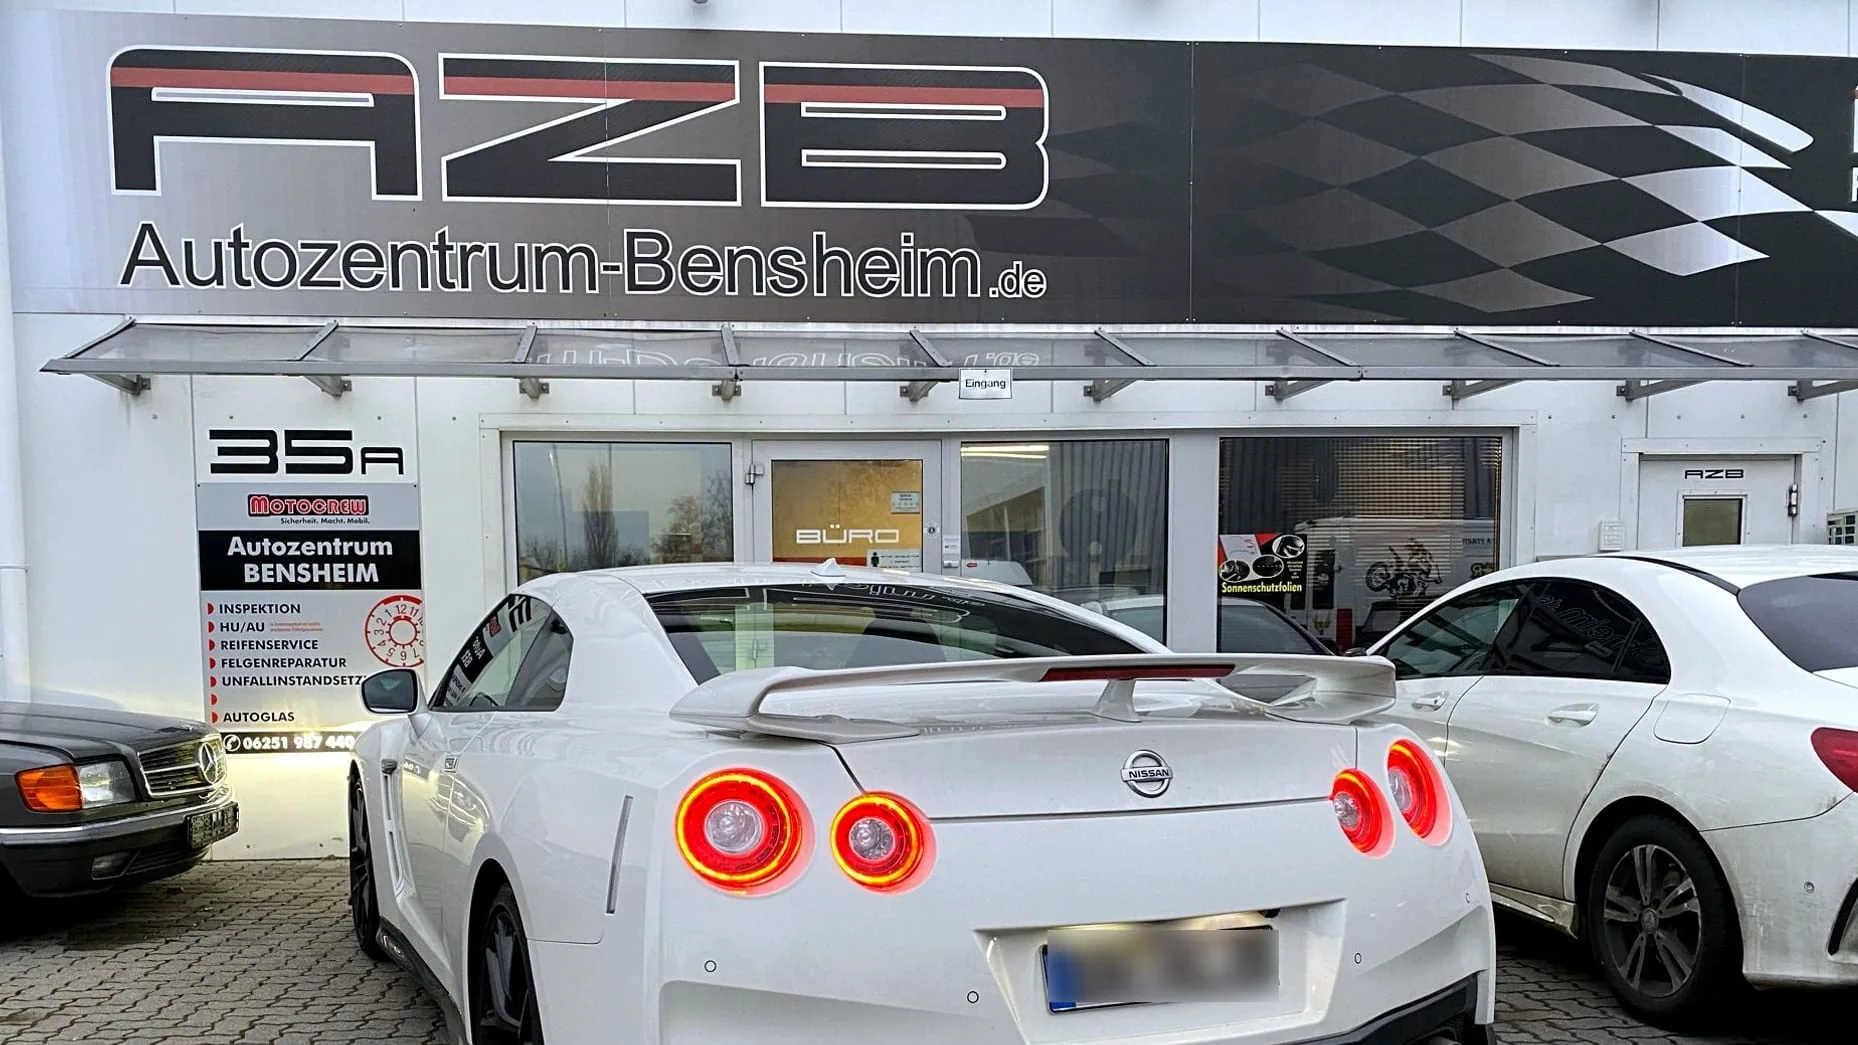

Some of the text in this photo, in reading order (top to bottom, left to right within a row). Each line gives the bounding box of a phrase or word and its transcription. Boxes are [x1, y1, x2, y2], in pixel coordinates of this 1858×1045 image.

[106, 44, 1050, 211] AZB
[965, 378, 1006, 389] Eingang
[1684, 469, 1744, 479] AZB
[795, 523, 900, 545] BÜRO
[226, 536, 393, 556] Autozentrum
[243, 563, 380, 583] BENSHEIM
[1221, 581, 1303, 593] Sonnenschutzfolien
[219, 603, 301, 614] INSPEKTION
[395, 603, 407, 615] 12
[220, 621, 265, 633] HU/AU
[220, 639, 319, 650] REIFENSERVICE
[221, 657, 347, 668] FELGENREPARATUR
[222, 675, 364, 687] UNFALLINSTANDSETZ
[223, 711, 295, 722] AUTOGLAS
[242, 736, 288, 750] 06251
[324, 735, 356, 750] 440
[1128, 768, 1170, 779] NISSAN
